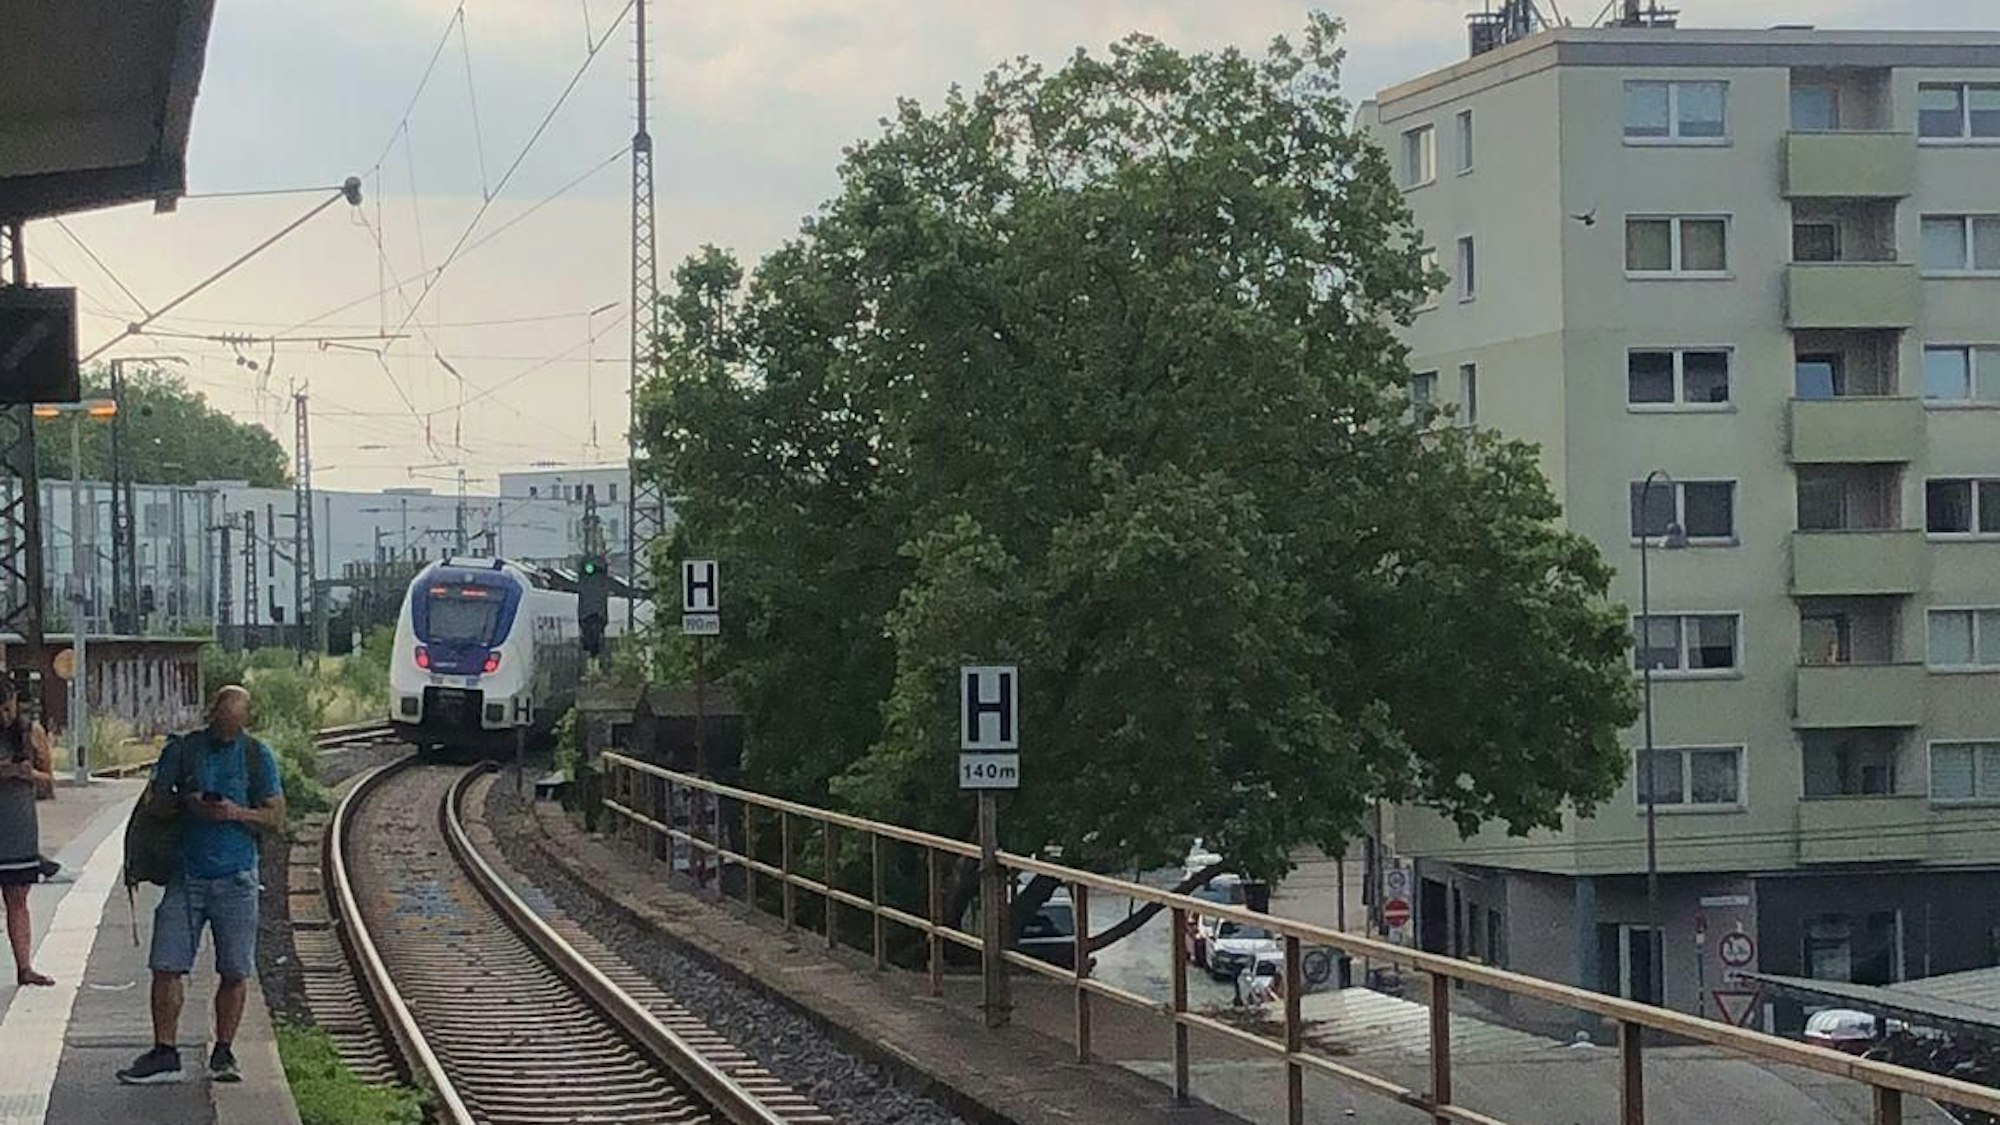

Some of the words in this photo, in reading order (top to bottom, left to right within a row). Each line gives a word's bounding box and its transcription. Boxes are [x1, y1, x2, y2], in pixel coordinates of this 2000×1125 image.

[687, 563, 714, 607] H
[514, 697, 530, 722] H
[967, 673, 1011, 742] H
[963, 763, 1015, 778] 140m
